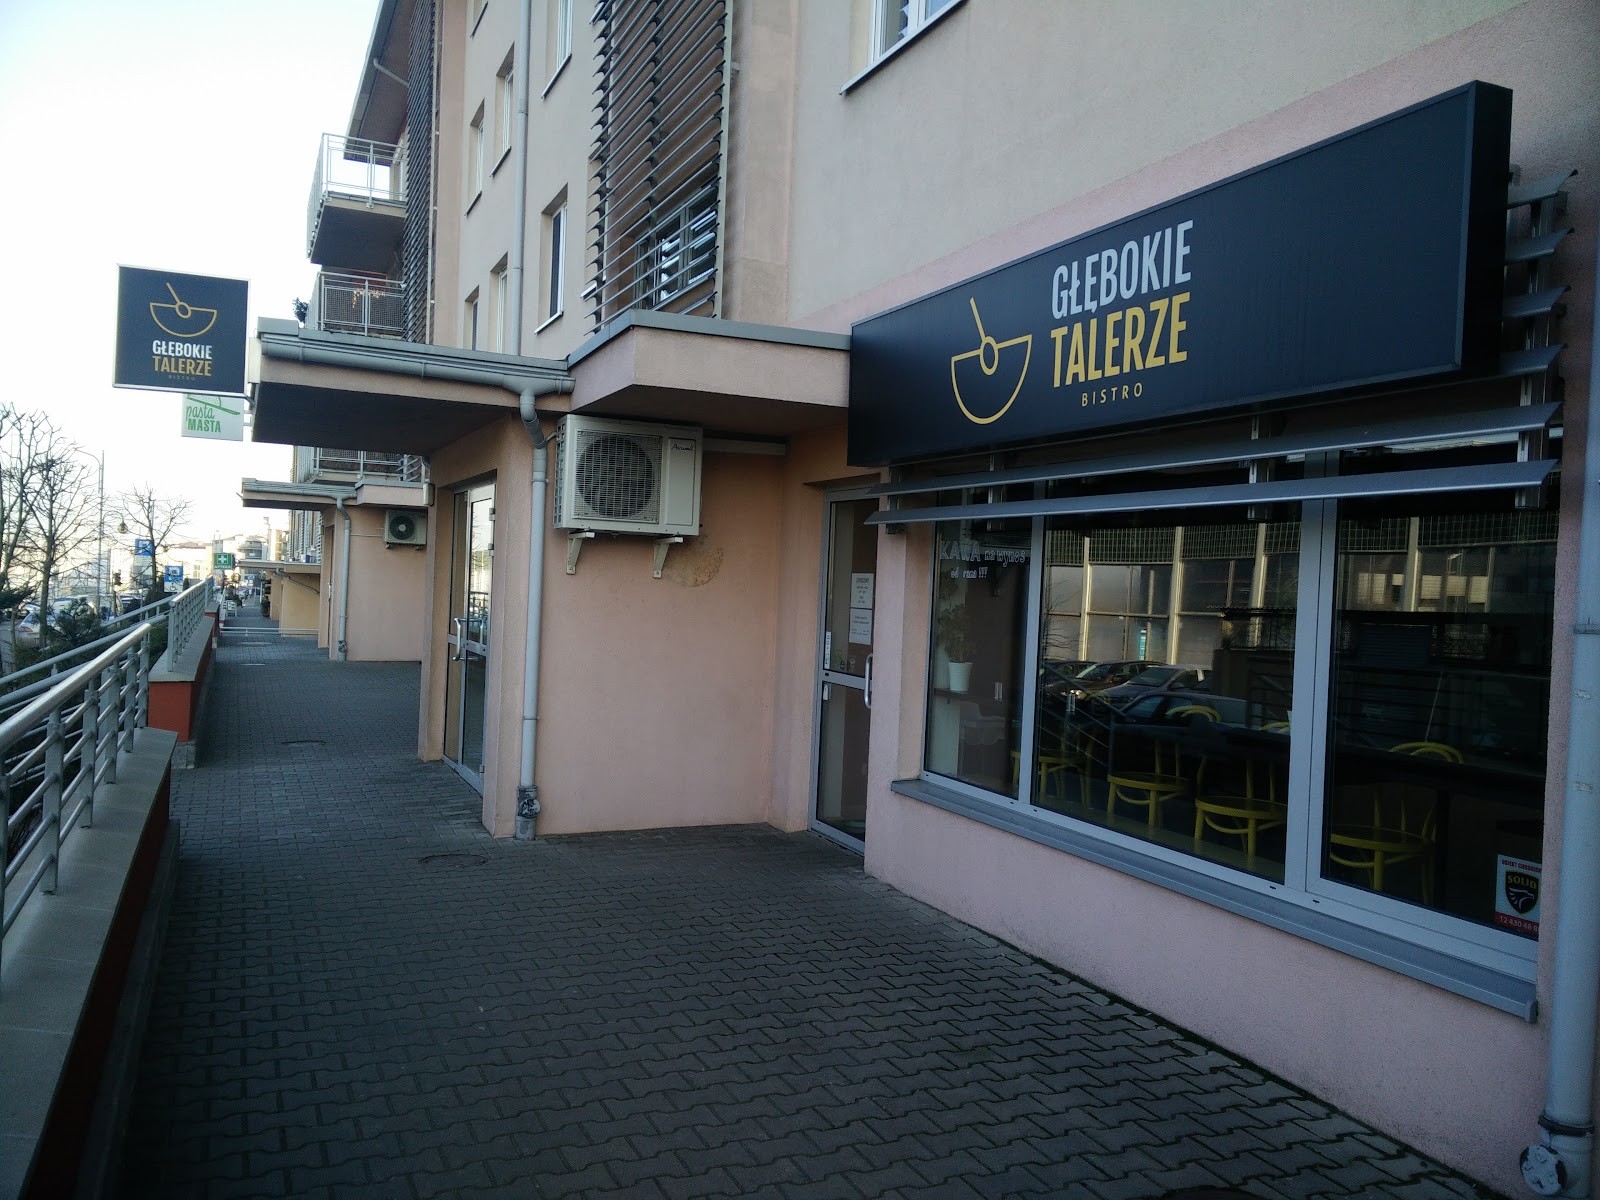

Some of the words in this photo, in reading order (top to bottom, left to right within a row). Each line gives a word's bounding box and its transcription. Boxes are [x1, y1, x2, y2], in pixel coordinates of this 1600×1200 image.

[1052, 220, 1194, 320] GŁĘBOKIE
[152, 340, 212, 359] GŁĘBOKIE
[1051, 292, 1190, 388] TALERZE
[152, 356, 212, 376] TALERZE
[1081, 382, 1143, 407] BISTRO
[186, 404, 215, 422] pasta
[188, 419, 221, 432] MASTA
[940, 540, 981, 562] KAWA
[1507, 875, 1537, 889] SOLID
